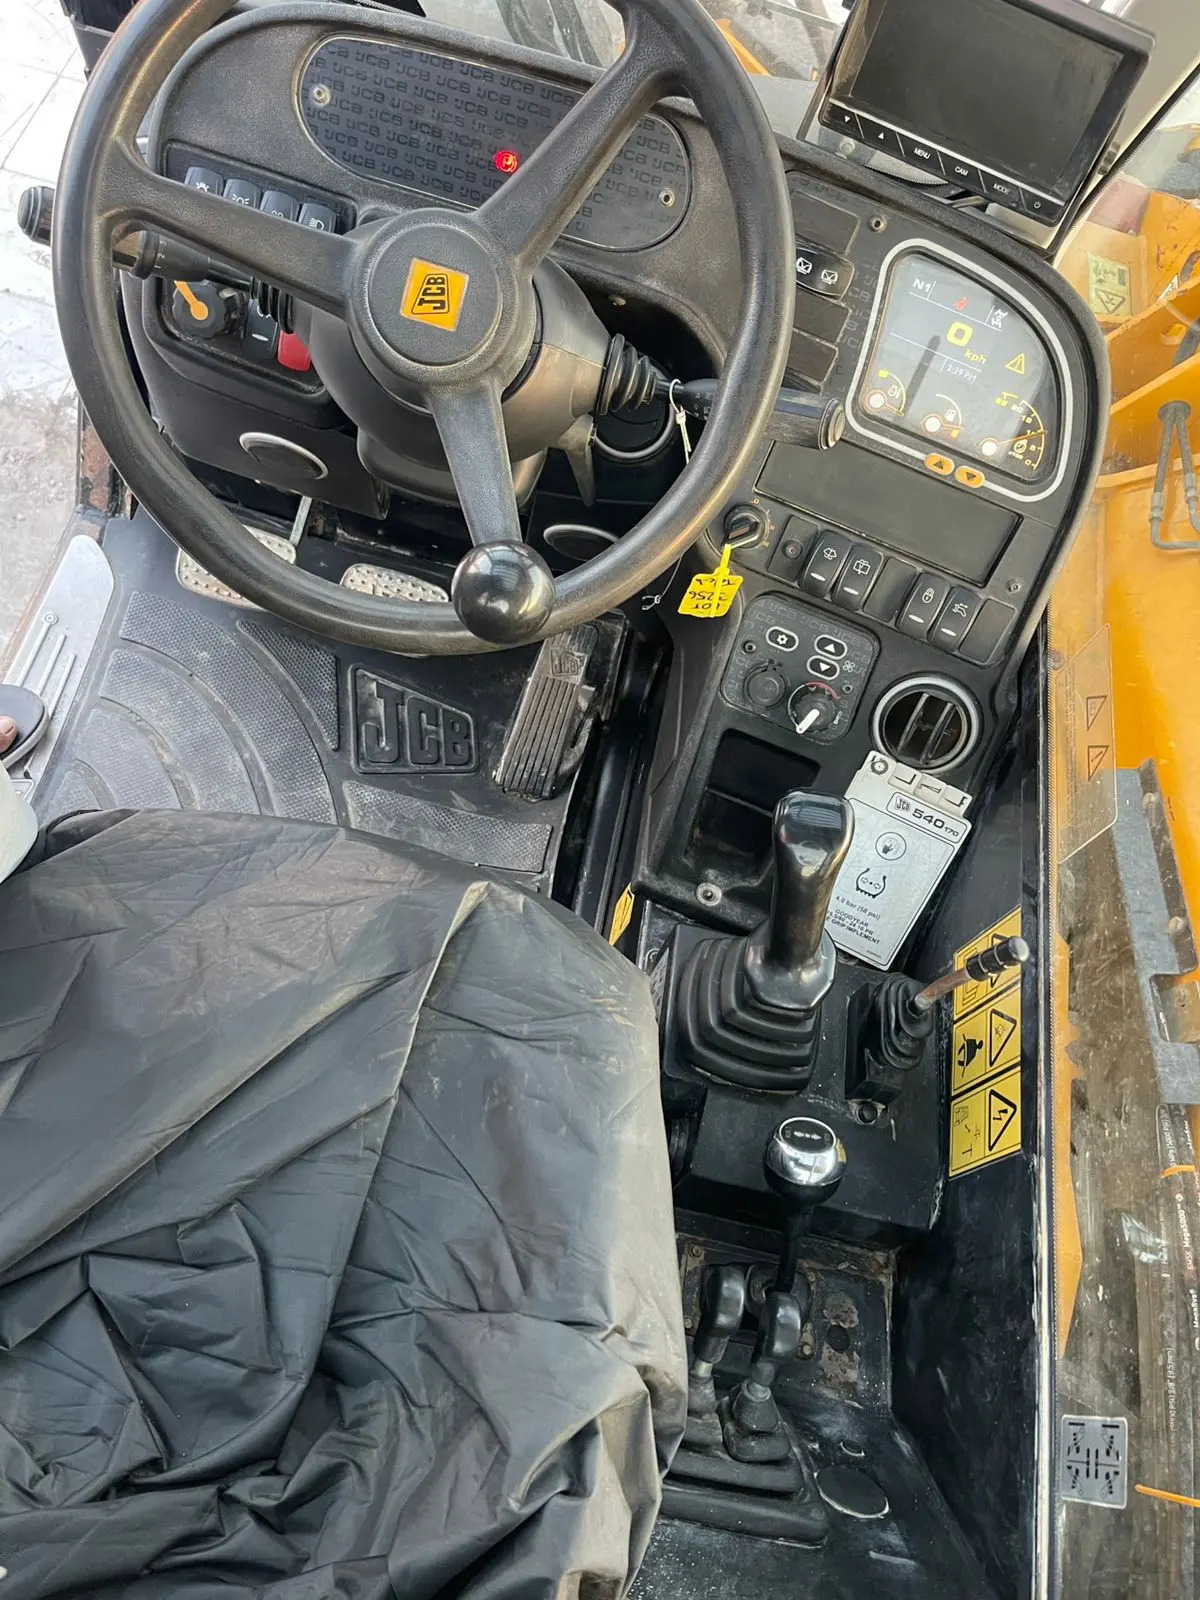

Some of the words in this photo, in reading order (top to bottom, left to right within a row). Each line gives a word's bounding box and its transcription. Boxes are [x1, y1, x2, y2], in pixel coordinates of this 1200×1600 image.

[623, 149, 648, 165] CB
[913, 147, 931, 160] MENU
[954, 166, 968, 177] CAM
[417, 276, 446, 310] JCB
[913, 279, 932, 292] N1
[964, 348, 986, 364] kph
[363, 680, 472, 766] JCB
[896, 797, 910, 811] JCB
[912, 808, 945, 829] 540
[945, 827, 959, 837] 170
[845, 900, 857, 908] bar
[836, 909, 869, 928] GOODYEAR
[831, 918, 846, 928] GRIP
[846, 925, 881, 945] IMPLEMENT
